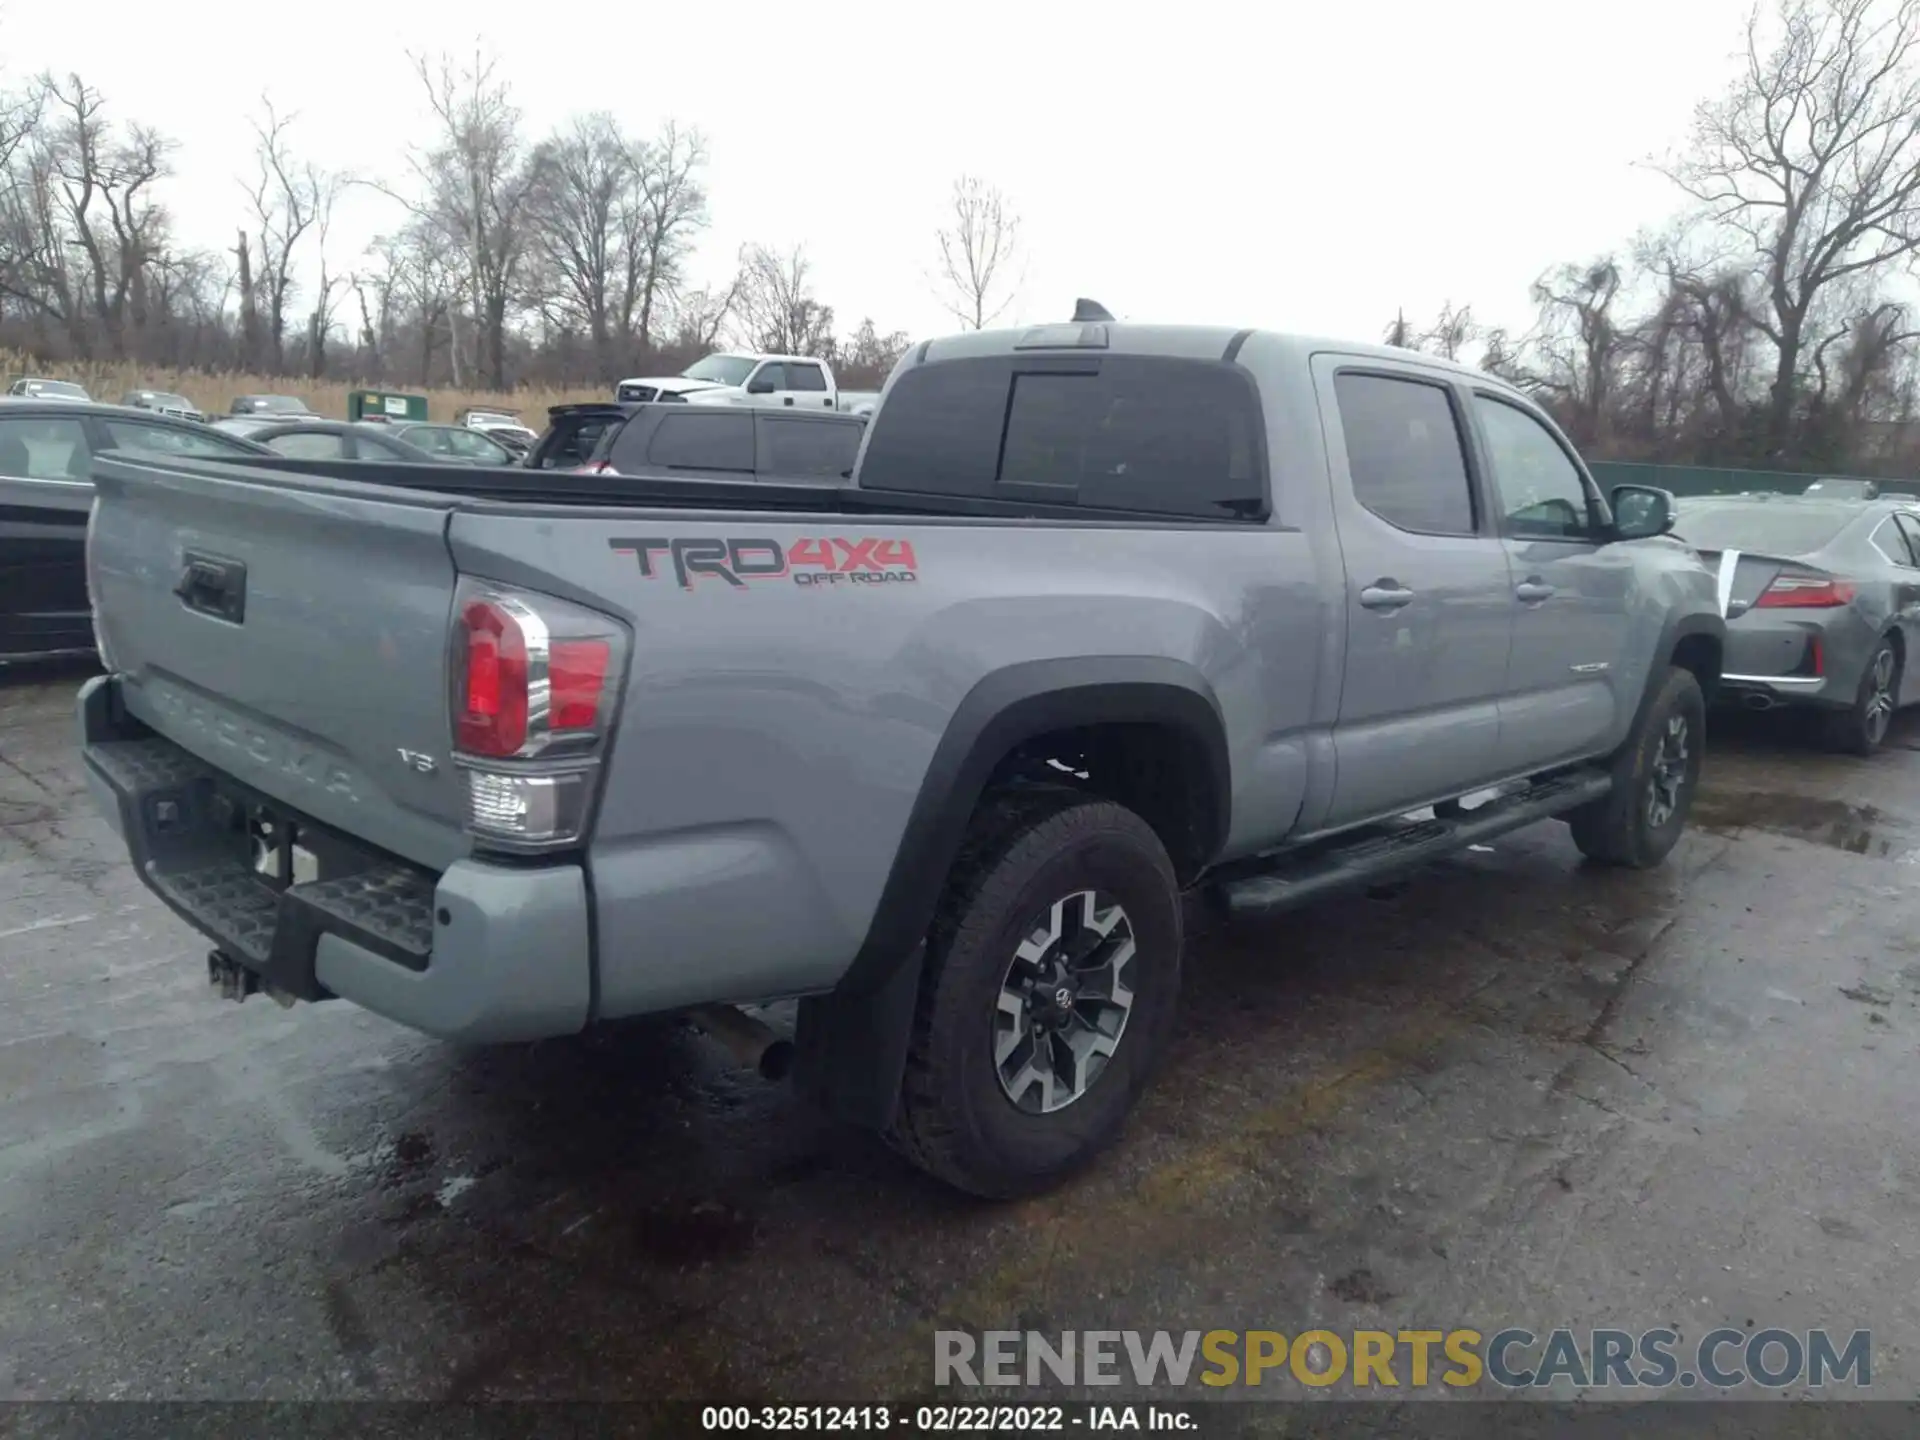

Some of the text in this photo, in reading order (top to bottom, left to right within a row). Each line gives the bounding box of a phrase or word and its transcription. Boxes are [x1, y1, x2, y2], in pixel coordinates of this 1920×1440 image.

[608, 536, 790, 591] TRD
[794, 571, 916, 585] OFF ROAD
